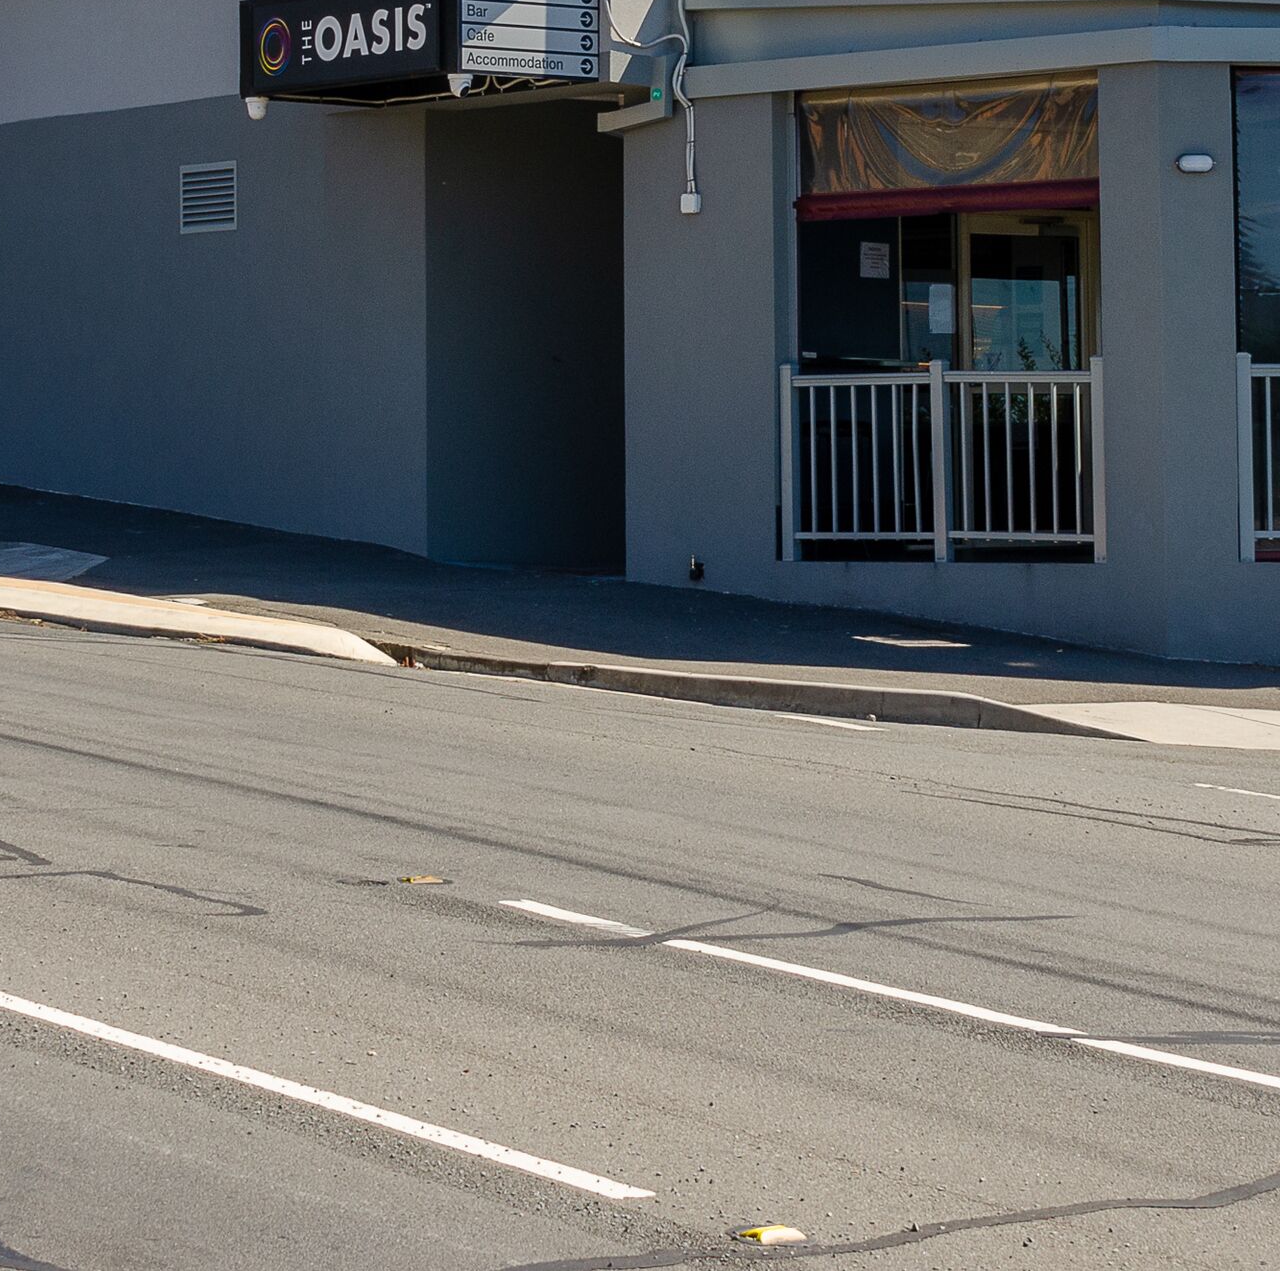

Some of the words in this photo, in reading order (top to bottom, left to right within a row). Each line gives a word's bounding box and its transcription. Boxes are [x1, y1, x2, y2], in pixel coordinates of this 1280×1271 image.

[466, 4, 488, 17] Bar
[301, 20, 312, 65] THE
[314, 3, 427, 62] OASIS
[466, 28, 495, 42] Cafe
[466, 52, 564, 70] Accommodation
